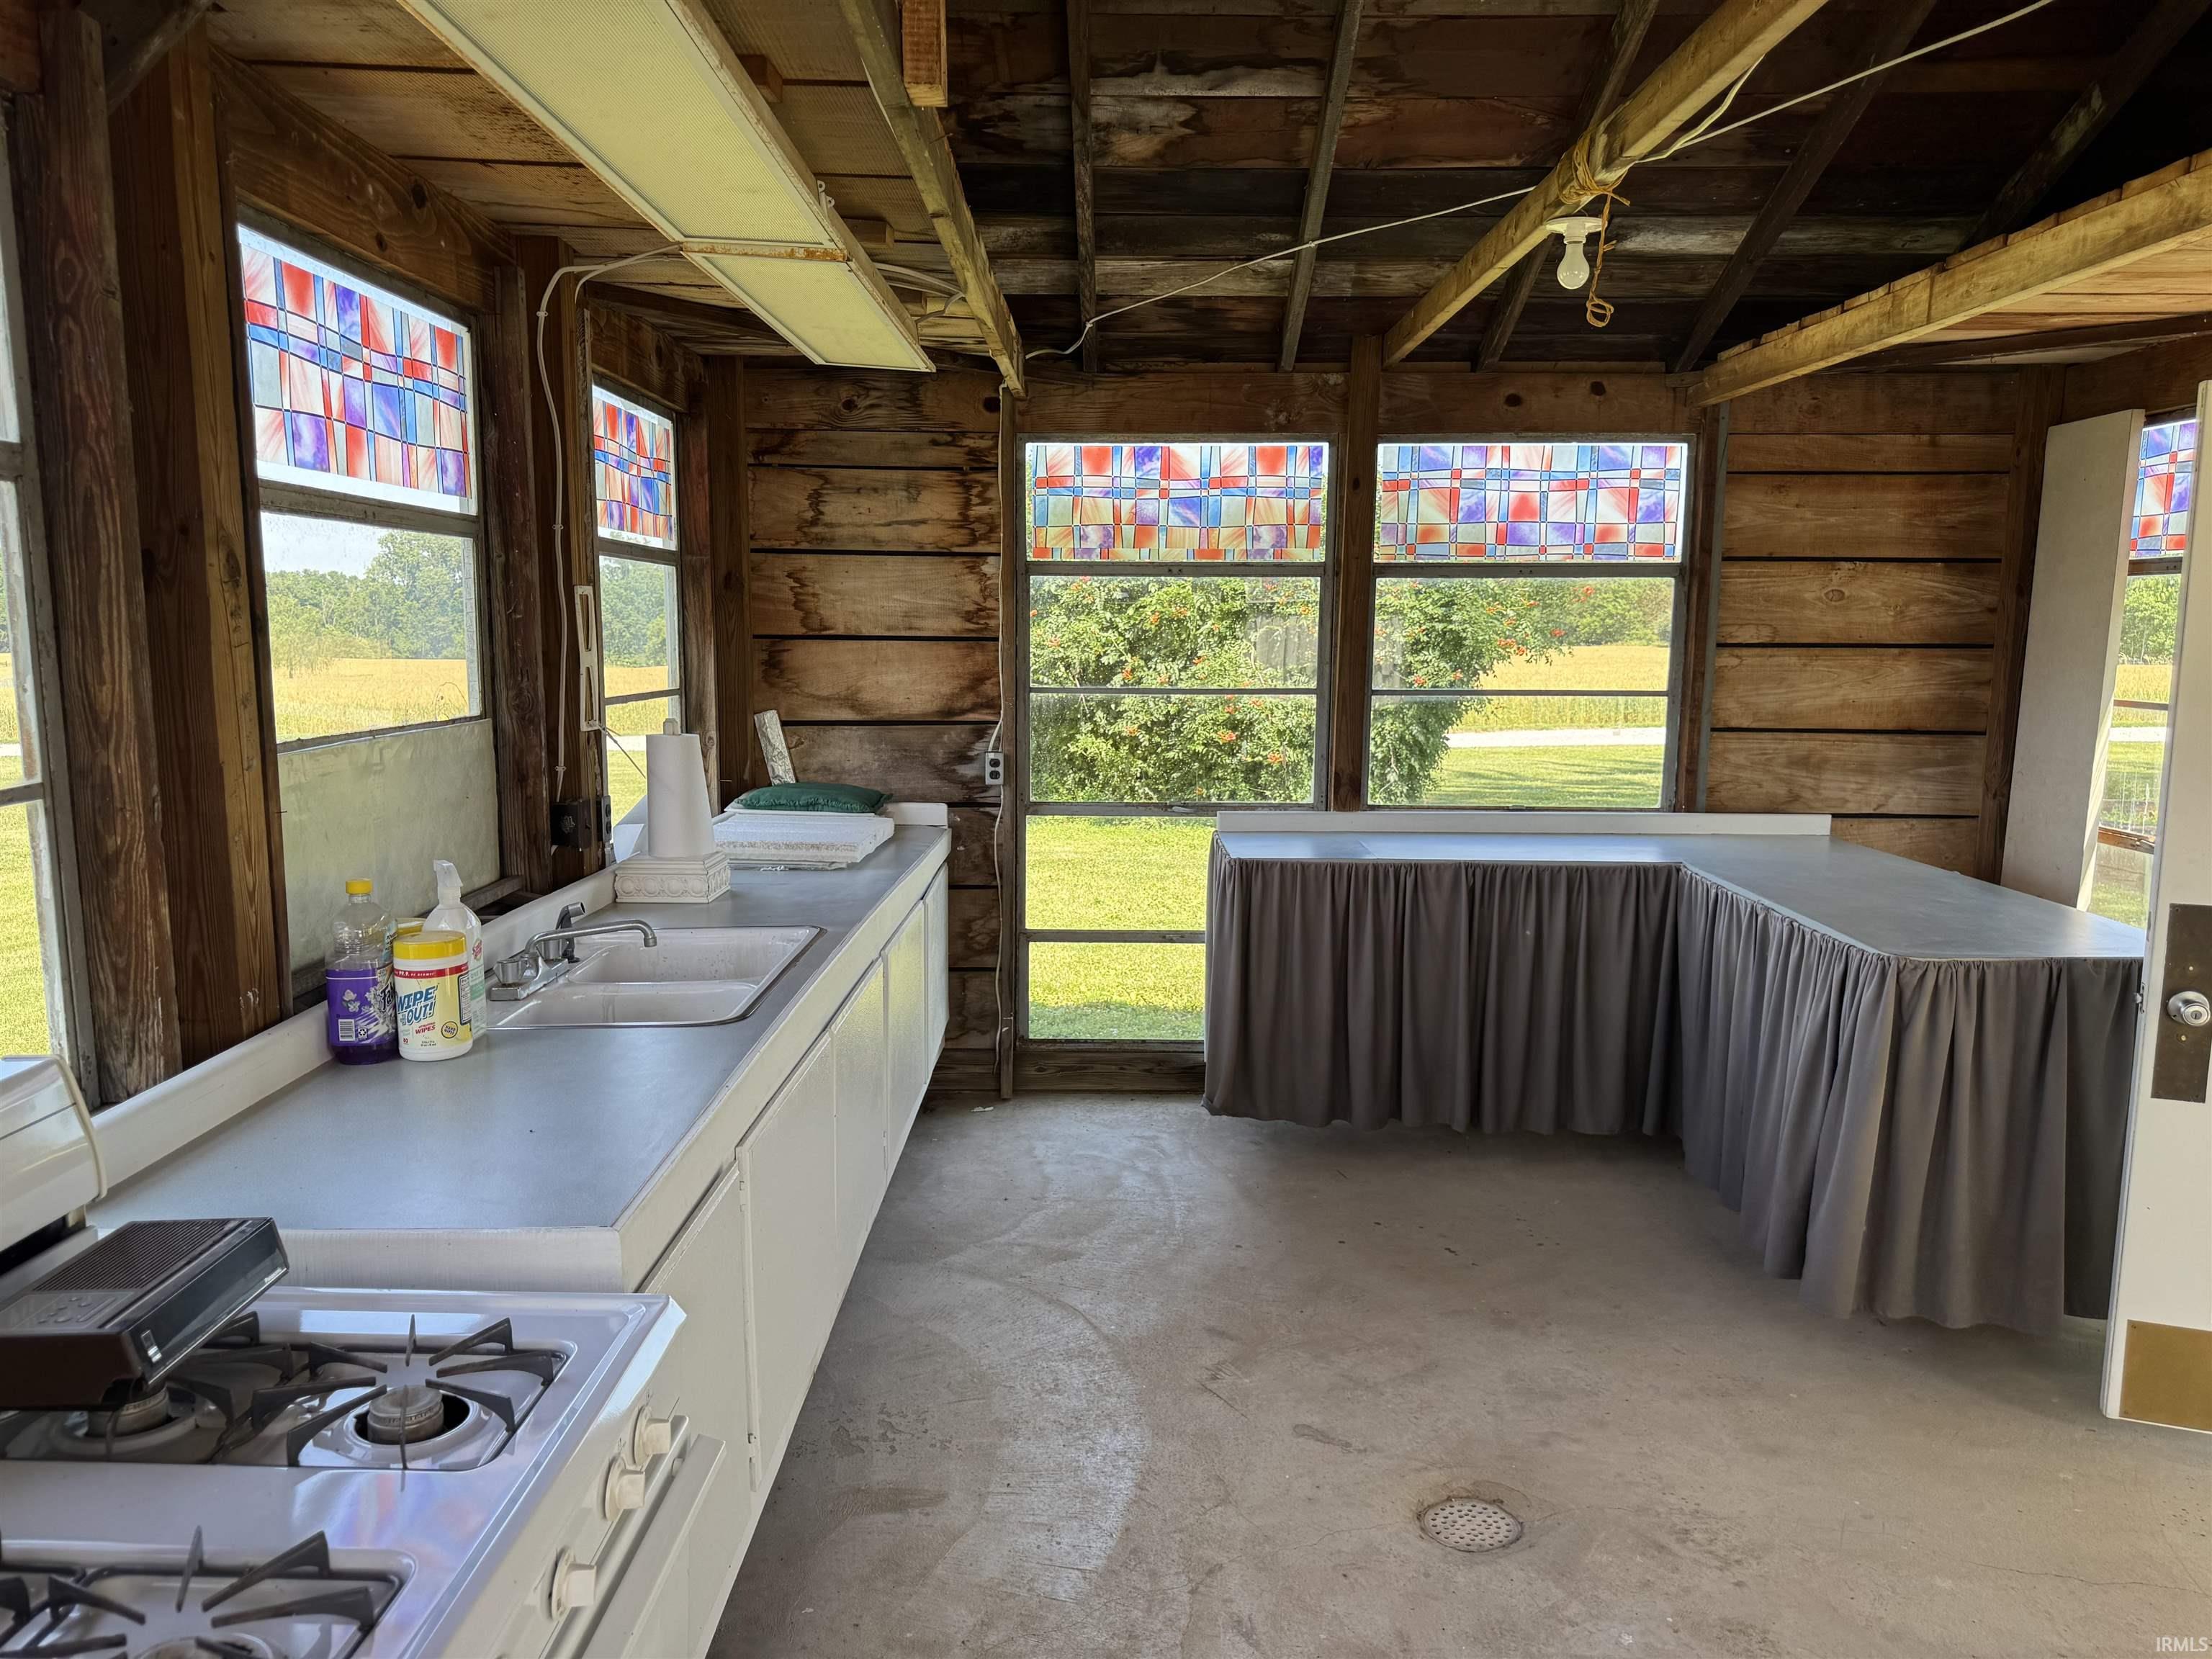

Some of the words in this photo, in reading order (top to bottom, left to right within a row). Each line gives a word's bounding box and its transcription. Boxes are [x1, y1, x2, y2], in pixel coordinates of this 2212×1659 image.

[397, 985, 436, 1012] WIPE
[407, 1002, 434, 1024] OUT!
[415, 1025, 436, 1035] WIPES
